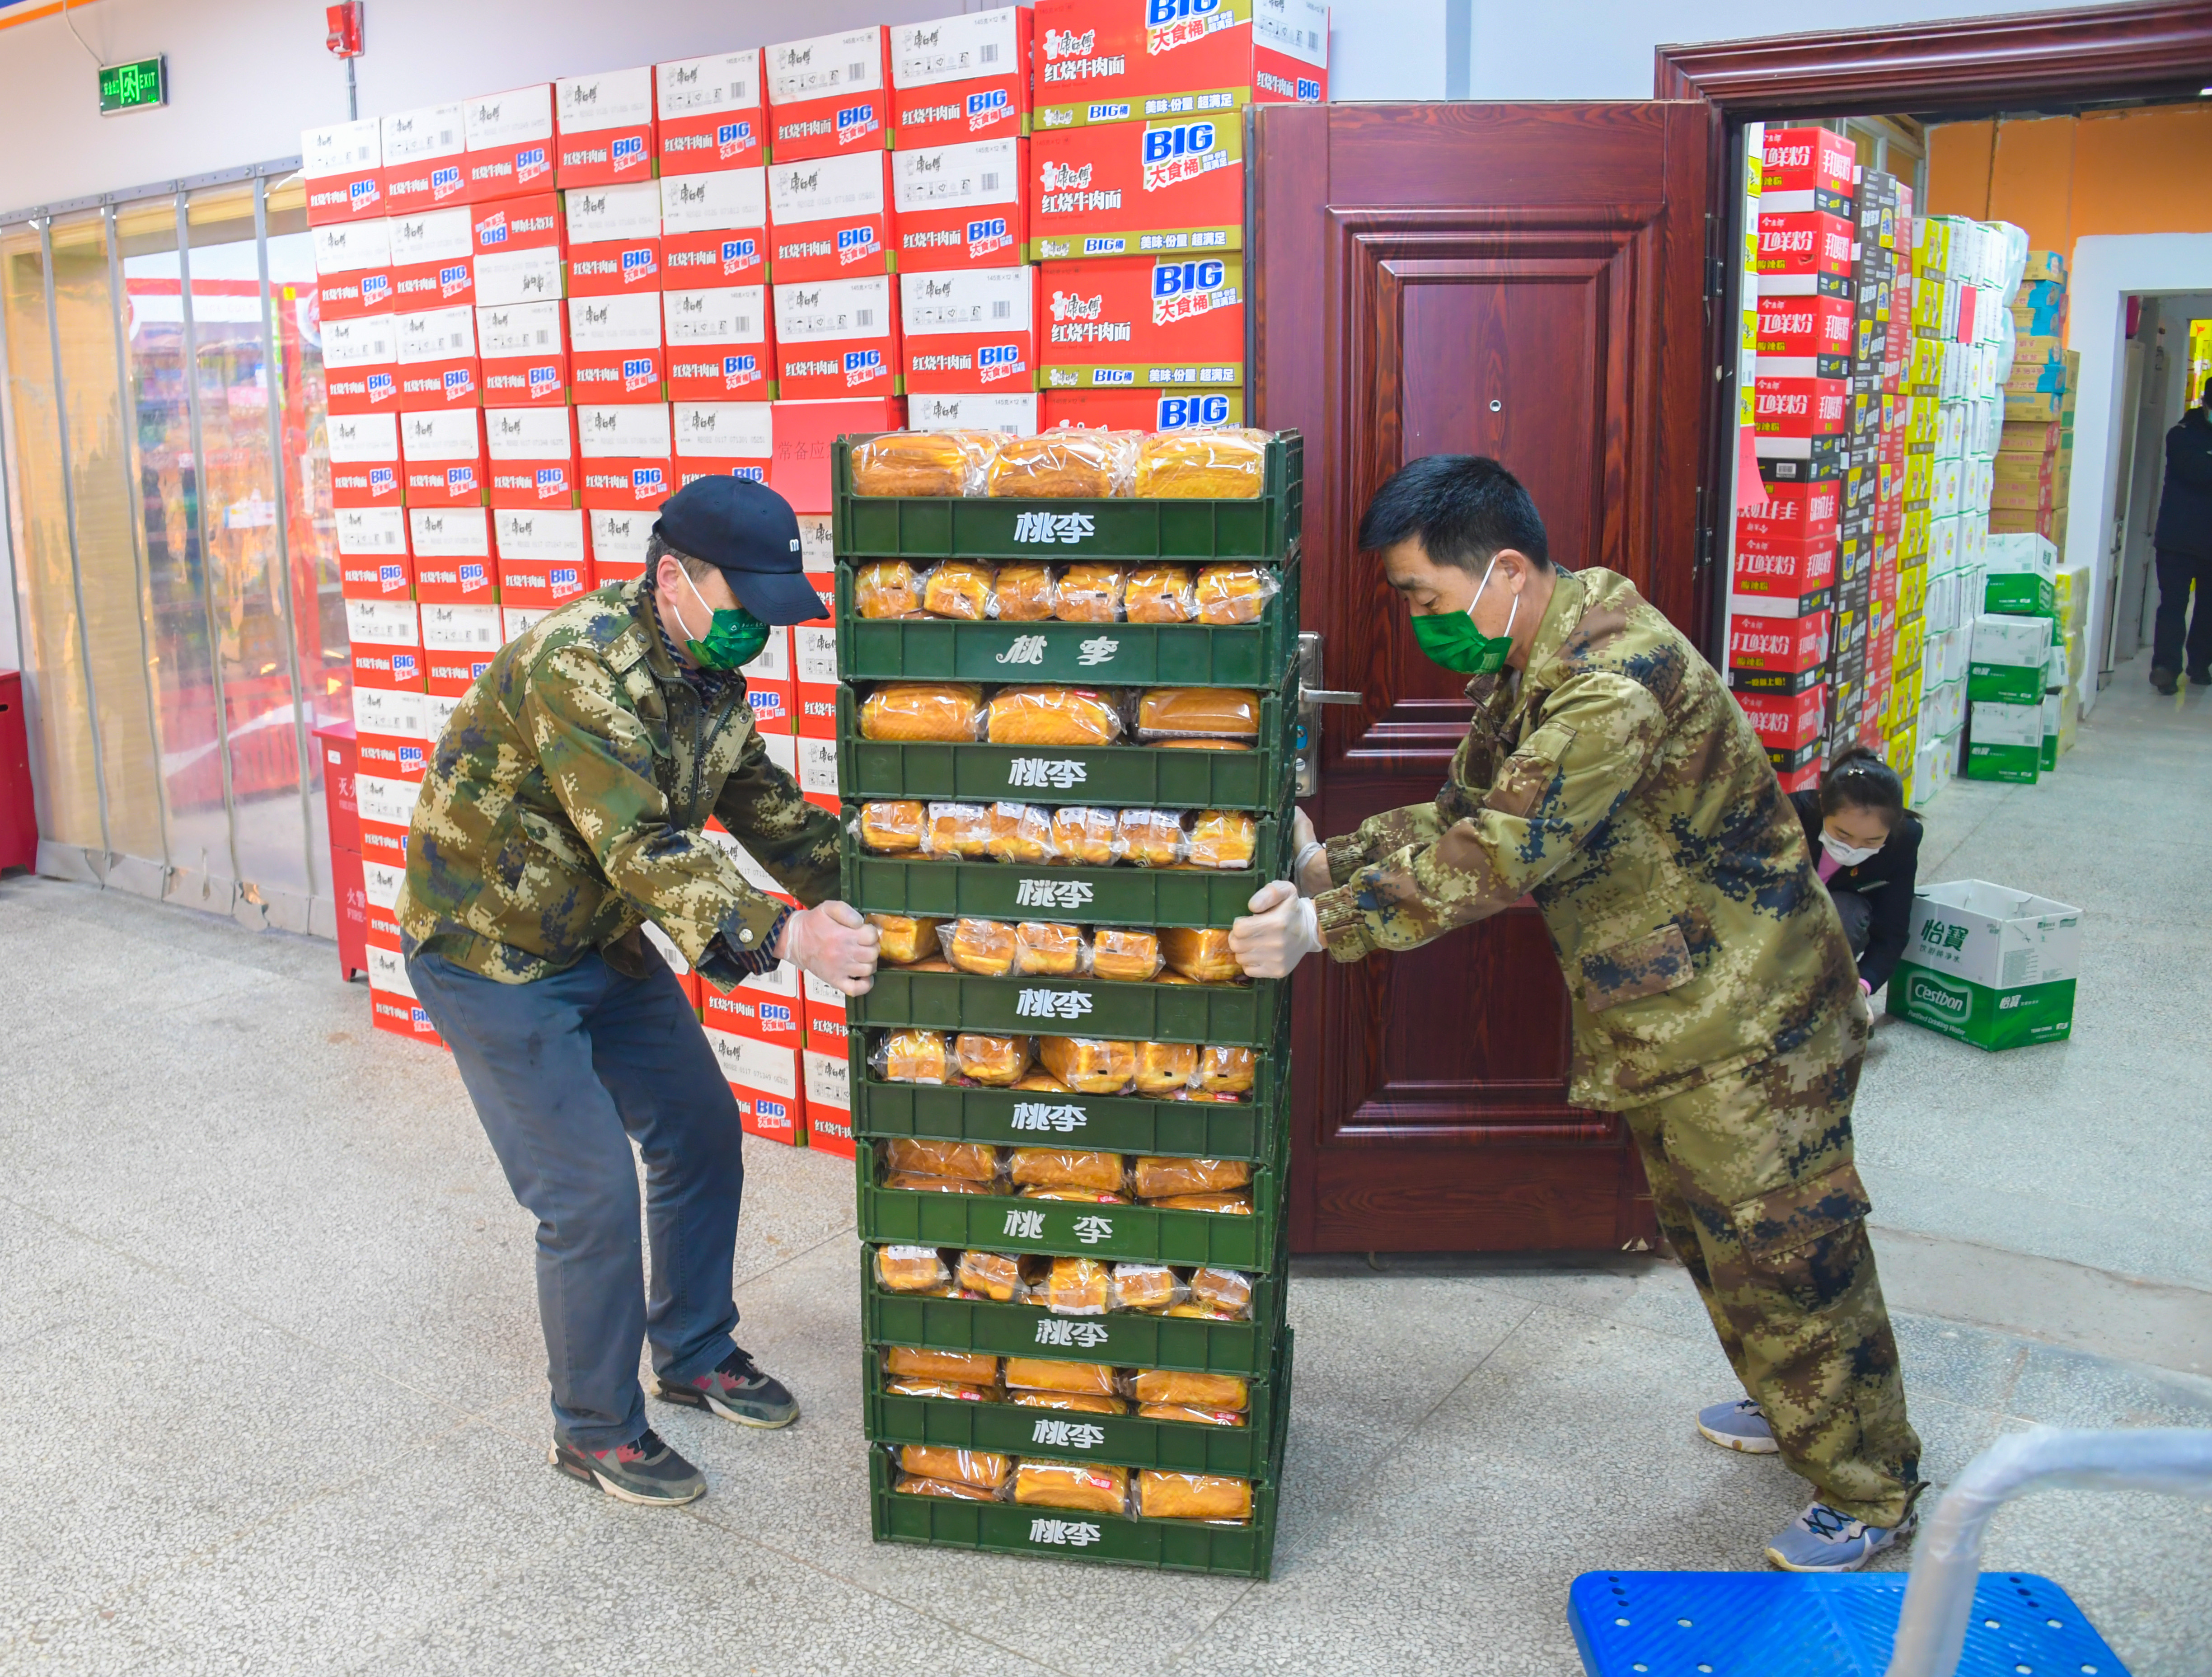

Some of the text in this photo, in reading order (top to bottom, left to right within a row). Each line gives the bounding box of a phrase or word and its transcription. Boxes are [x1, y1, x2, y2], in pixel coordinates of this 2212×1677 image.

[1153, 19, 1204, 52] 大食桶
[1045, 56, 1124, 81] 红烧牛肉面
[139, 72, 155, 89] EXIT
[1298, 80, 1319, 100] BIG
[968, 90, 1007, 114] BIG
[1197, 94, 1233, 109] 超满足
[838, 105, 872, 128] BIG
[902, 103, 960, 125] 红烧牛肉面
[1088, 104, 1129, 119] BIG桶
[779, 119, 831, 139] 红烧牛肉面
[969, 112, 1000, 131] 大食桶
[665, 134, 712, 151] 红烧牛肉面
[719, 123, 750, 144] BIG
[613, 137, 641, 158] BIG
[1144, 124, 1213, 164] BIG
[517, 149, 543, 168] BIG
[433, 168, 458, 187] BIG
[1150, 158, 1200, 188] 大食桶
[351, 180, 374, 198] BIG
[1042, 190, 1121, 213] 红烧牛肉面
[838, 227, 872, 249] BIG
[904, 230, 961, 248] 红烧牛肉面
[969, 219, 1005, 241] BIG
[1191, 231, 1227, 246] 超满足
[723, 240, 754, 260] BIG
[779, 240, 831, 259] 红烧牛肉面
[970, 239, 1000, 258] 大食桶
[1086, 239, 1124, 252] BIG桶
[623, 250, 651, 269] BIG
[668, 250, 716, 266] 红烧牛肉面
[363, 276, 386, 293] BIG
[441, 267, 466, 284] BIG
[1153, 262, 1223, 298] BIG
[1159, 295, 1209, 323] 大食桶
[1051, 322, 1130, 342] 红烧牛肉面
[725, 356, 755, 374] BIG
[845, 350, 880, 370] BIG
[913, 355, 971, 370] 红烧牛肉面
[979, 346, 1018, 366] BIG
[530, 368, 555, 384] BIG
[624, 360, 651, 377] BIG
[673, 364, 719, 377] 红烧牛肉面
[786, 360, 838, 376] 红烧牛肉面
[981, 365, 1011, 383] 大食桶
[1094, 370, 1133, 382] BIG桶
[1200, 367, 1234, 382] 超满足
[369, 374, 390, 390] BIG
[445, 370, 468, 387] BIG
[1158, 396, 1228, 431] BIG
[778, 440, 831, 461] 常备应
[371, 470, 391, 483] BIG
[449, 468, 471, 483] BIG
[537, 469, 562, 484] BIG
[634, 469, 661, 486] BIG
[1014, 512, 1095, 543] 桃李
[381, 567, 400, 580] BIG
[461, 565, 482, 580] BIG
[551, 570, 575, 584] BIG
[394, 656, 413, 669] BIG
[749, 693, 779, 707] BIG
[400, 747, 421, 760] BIG
[1008, 758, 1087, 788] 桃李
[1016, 879, 1093, 908] 桃李
[709, 996, 754, 1017] 红烧牛肉面
[761, 1004, 789, 1020] BIG
[1016, 988, 1092, 1018] 桃李
[757, 1100, 784, 1116] BIG
[1012, 1103, 1087, 1131] 桃李
[1036, 1319, 1108, 1347] 桃李
[1032, 1419, 1104, 1448] 桃李
[1030, 1519, 1101, 1546] 桃李
